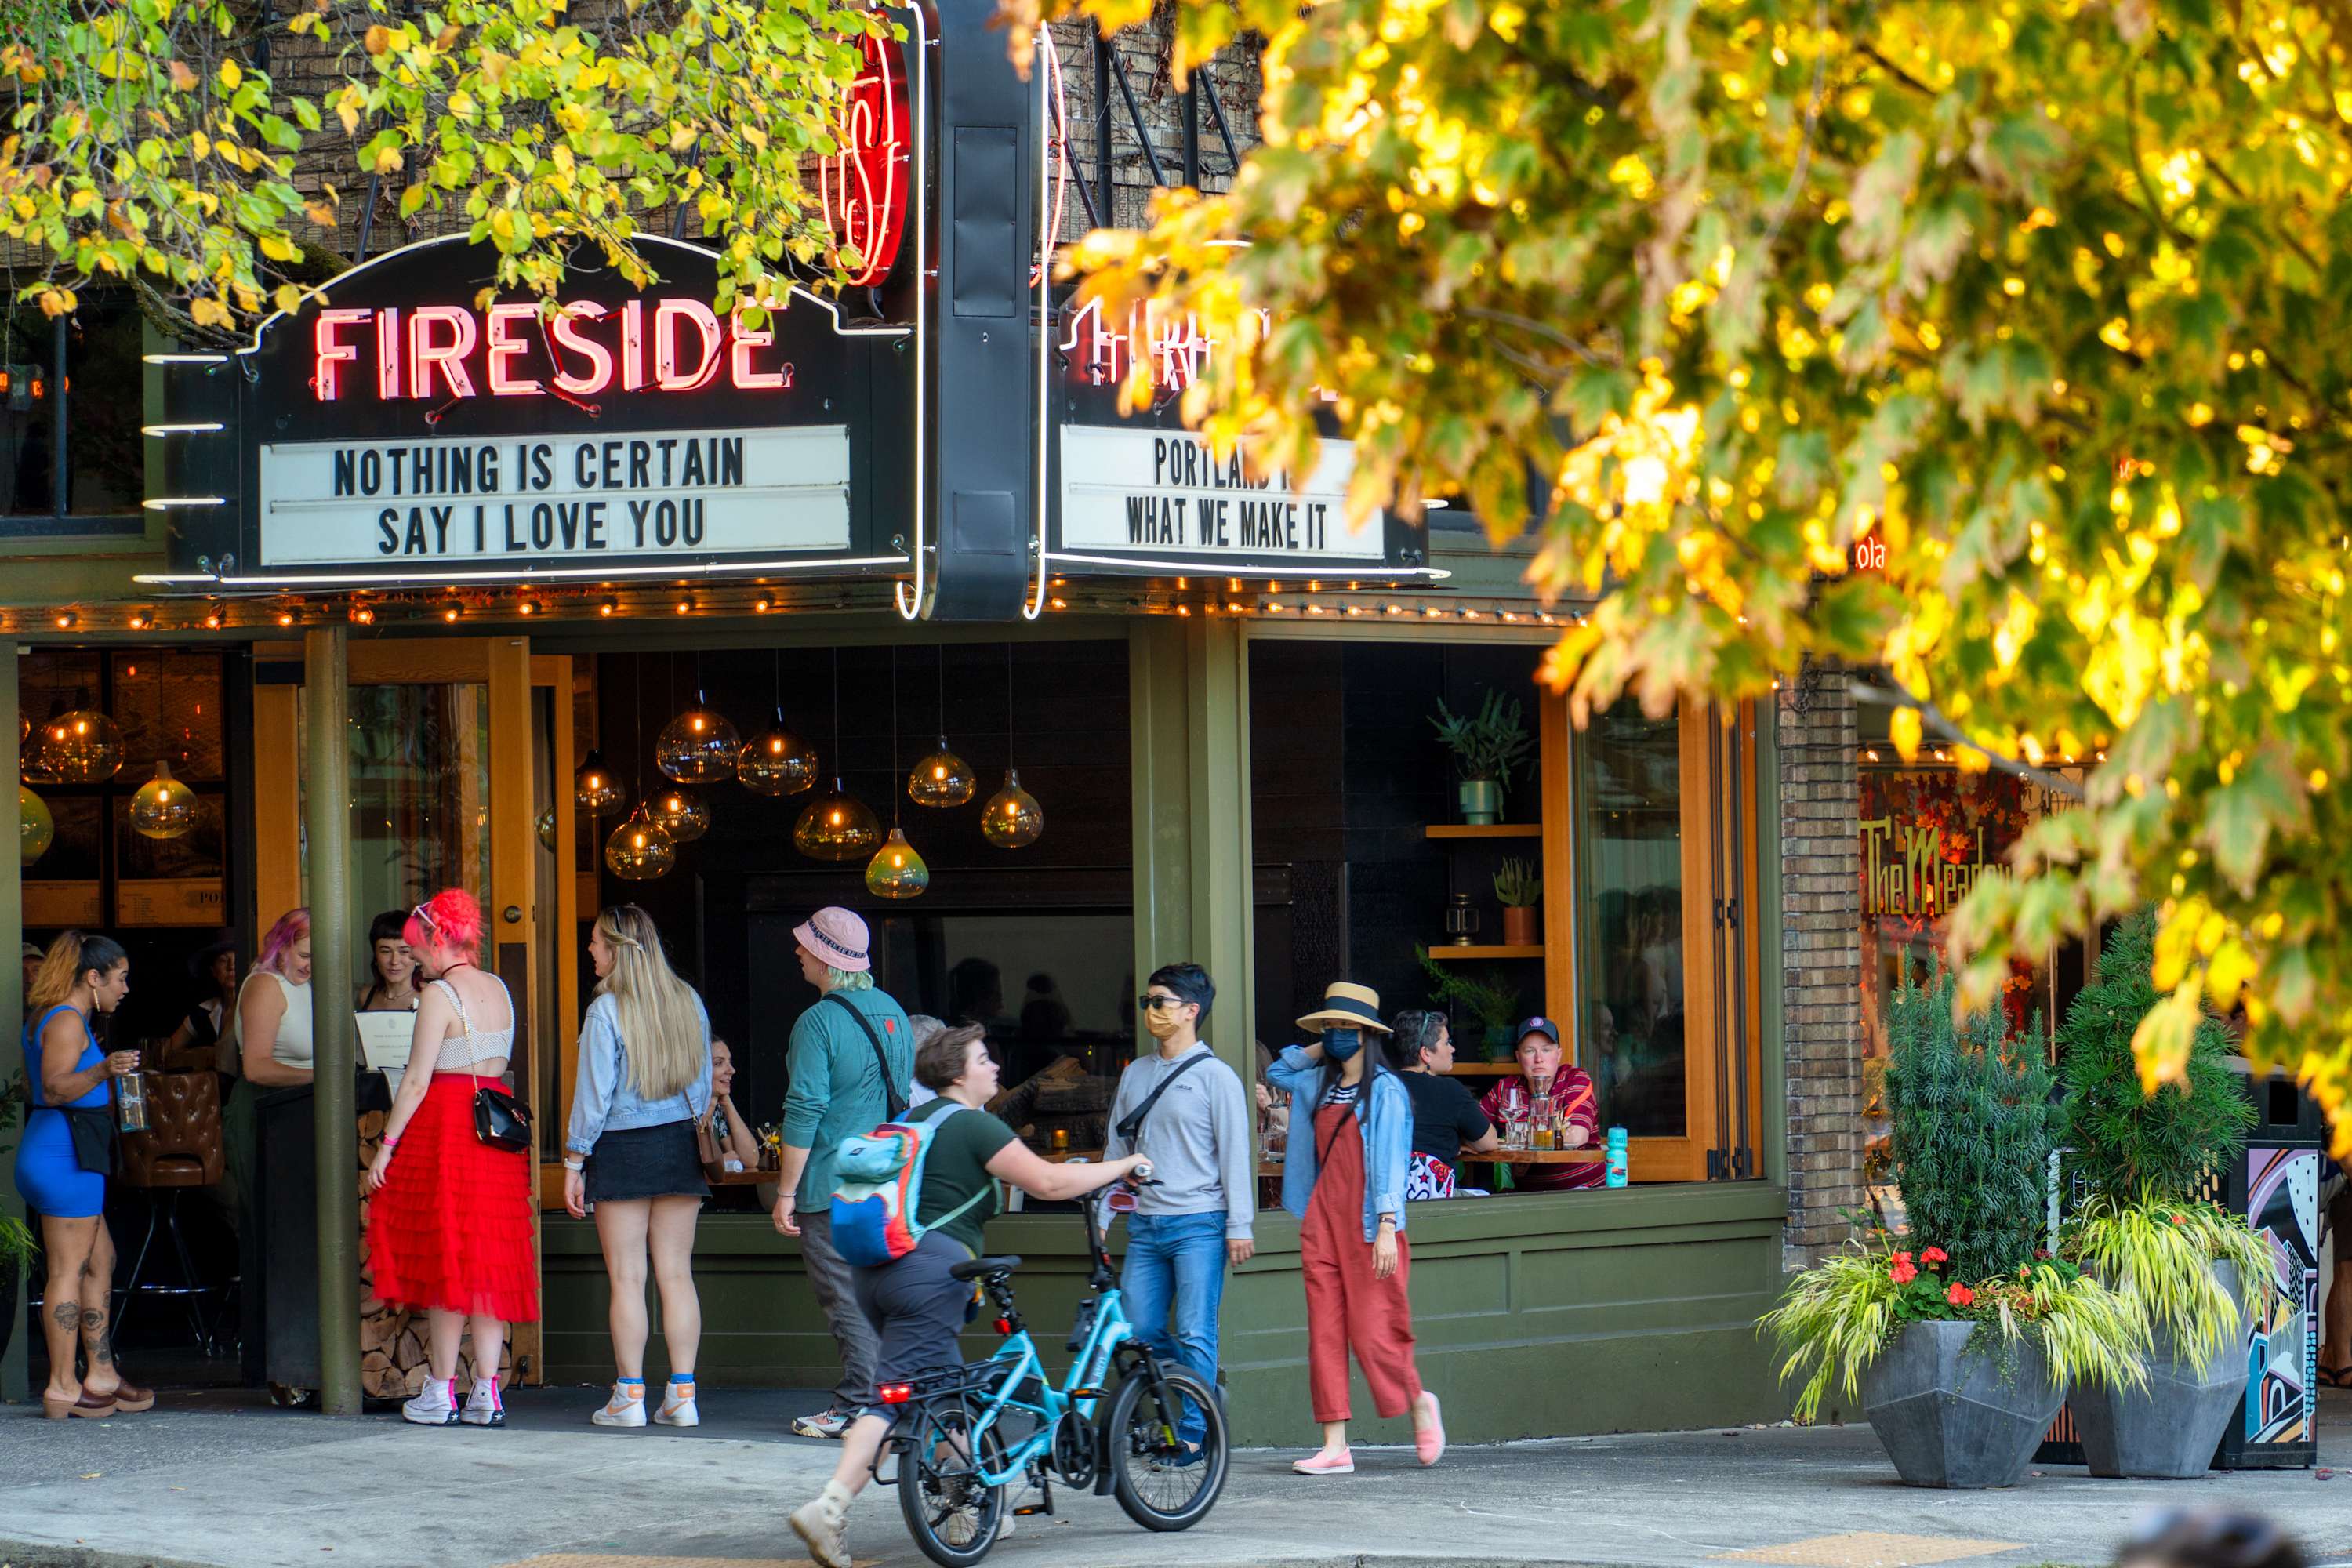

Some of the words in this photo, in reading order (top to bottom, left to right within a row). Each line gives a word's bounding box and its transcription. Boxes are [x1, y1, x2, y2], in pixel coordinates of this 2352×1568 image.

[316, 298, 791, 401] FIRESIDE
[335, 446, 499, 496] NOTHING
[517, 444, 552, 491] IS
[575, 437, 743, 489] CERTAIN
[379, 506, 453, 554] SAY
[474, 506, 484, 552] I
[505, 503, 606, 552] LOVE
[628, 499, 703, 546] YOU
[1127, 495, 1186, 544] WHAT
[1198, 499, 1229, 546] WE
[1240, 500, 1298, 550] MAKE
[1307, 503, 1326, 550] IT
